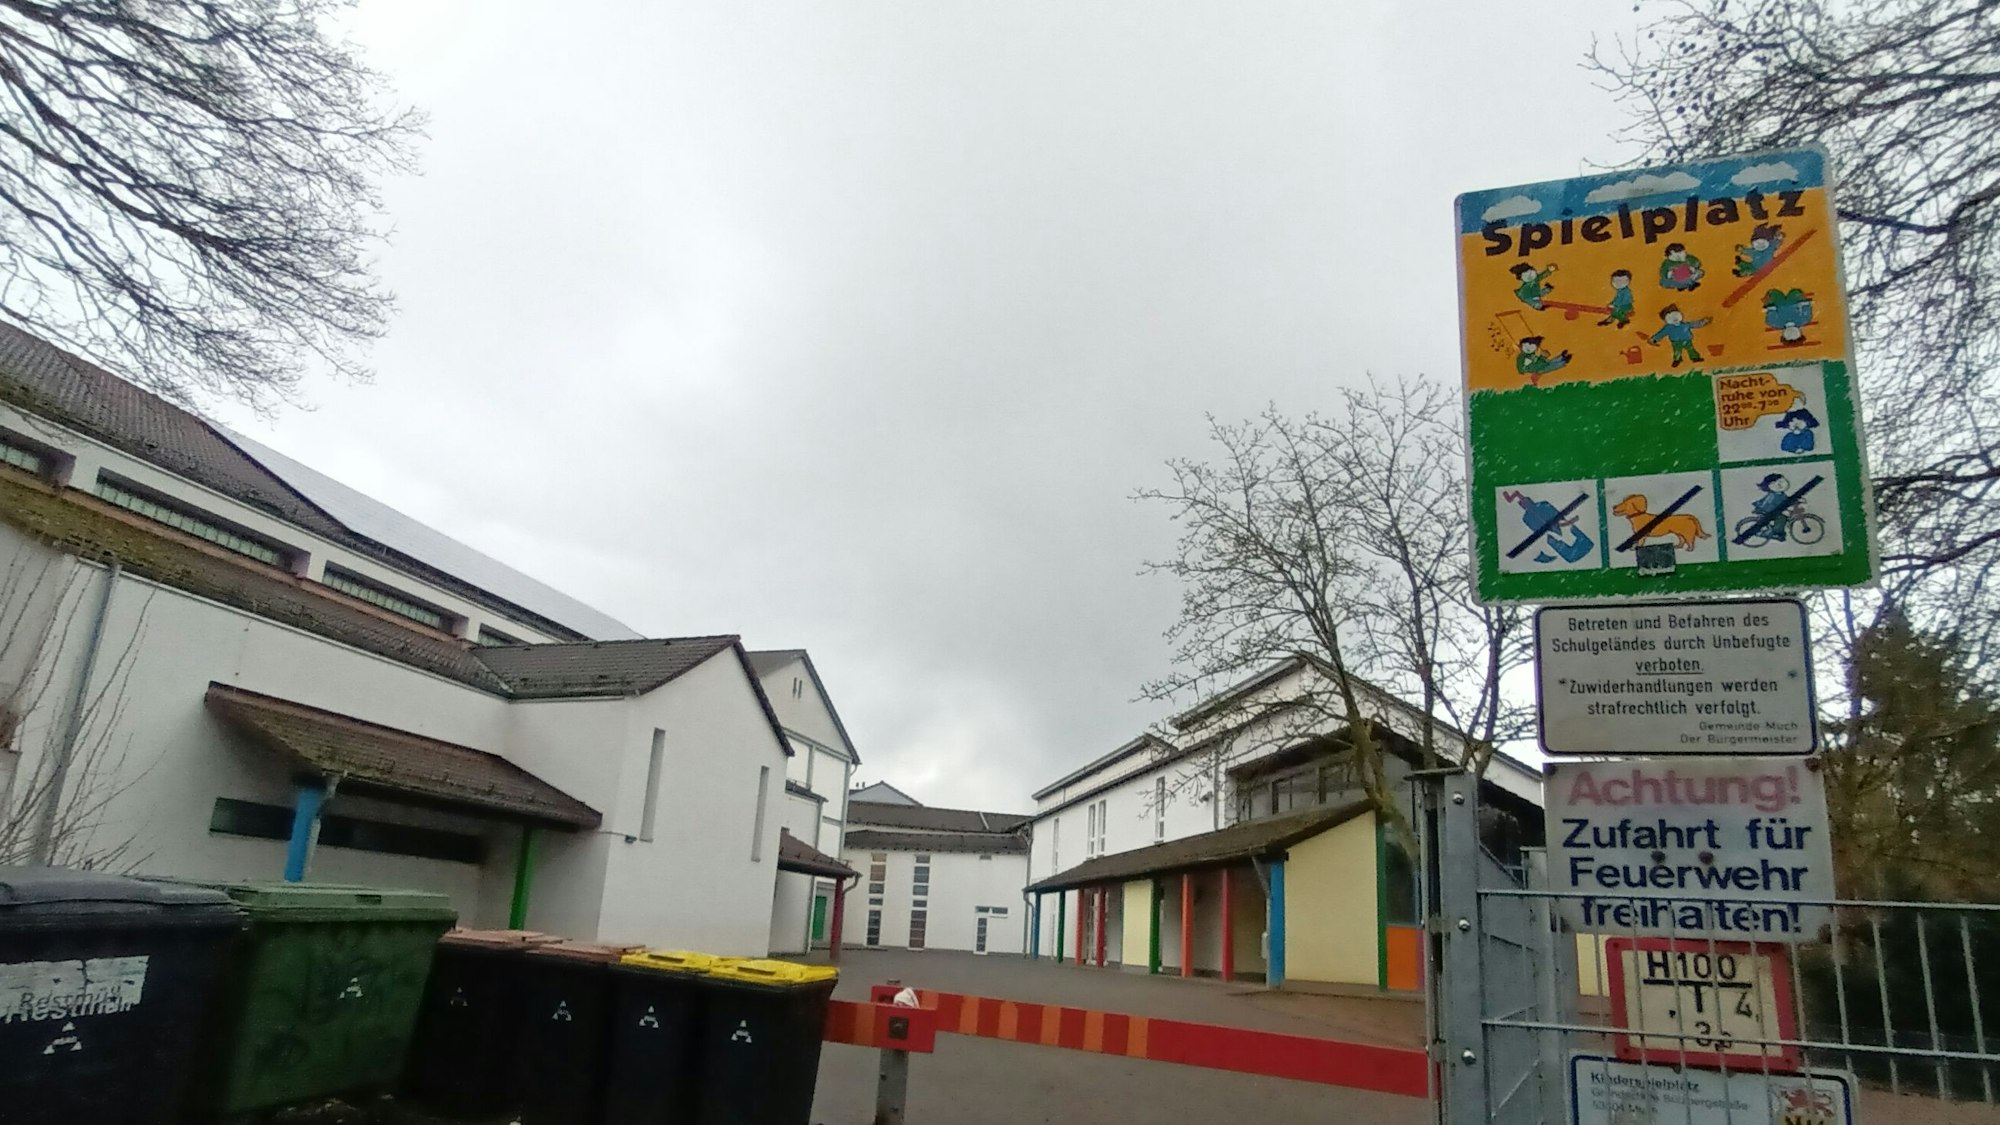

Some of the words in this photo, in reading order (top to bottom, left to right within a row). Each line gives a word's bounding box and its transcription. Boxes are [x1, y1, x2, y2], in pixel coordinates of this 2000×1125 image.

[1481, 187, 1806, 257] Spielplatz
[1720, 376, 1771, 390] Nacht-
[1721, 391, 1754, 401] ruhe
[1760, 388, 1788, 398] von
[1724, 416, 1750, 427] Uhr
[1568, 616, 1628, 632] Betreten
[1635, 615, 1661, 629] und
[1669, 614, 1735, 629] Befahren
[1743, 612, 1770, 627] des
[1552, 637, 1656, 656] Schulgeländes
[1664, 634, 1706, 651] durch
[1713, 634, 1791, 650] Unbefugte
[1635, 658, 1705, 674] verboten.
[1570, 680, 1713, 698] Zuwiderhandlungen
[1721, 678, 1778, 693] werden
[1587, 700, 1687, 716] strafrechtlich
[1695, 700, 1761, 717] verfolgt.
[1699, 721, 1760, 732] Gemeinde
[1764, 721, 1798, 731] Much
[1680, 734, 1701, 744] Der
[1567, 766, 1802, 813] Achtung!
[1562, 818, 1722, 849] Zufahrt
[1746, 817, 1812, 849] für
[1570, 857, 1809, 891] Feuerwehr
[1581, 897, 1803, 933] freihaten!
[1646, 950, 1737, 980] H100
